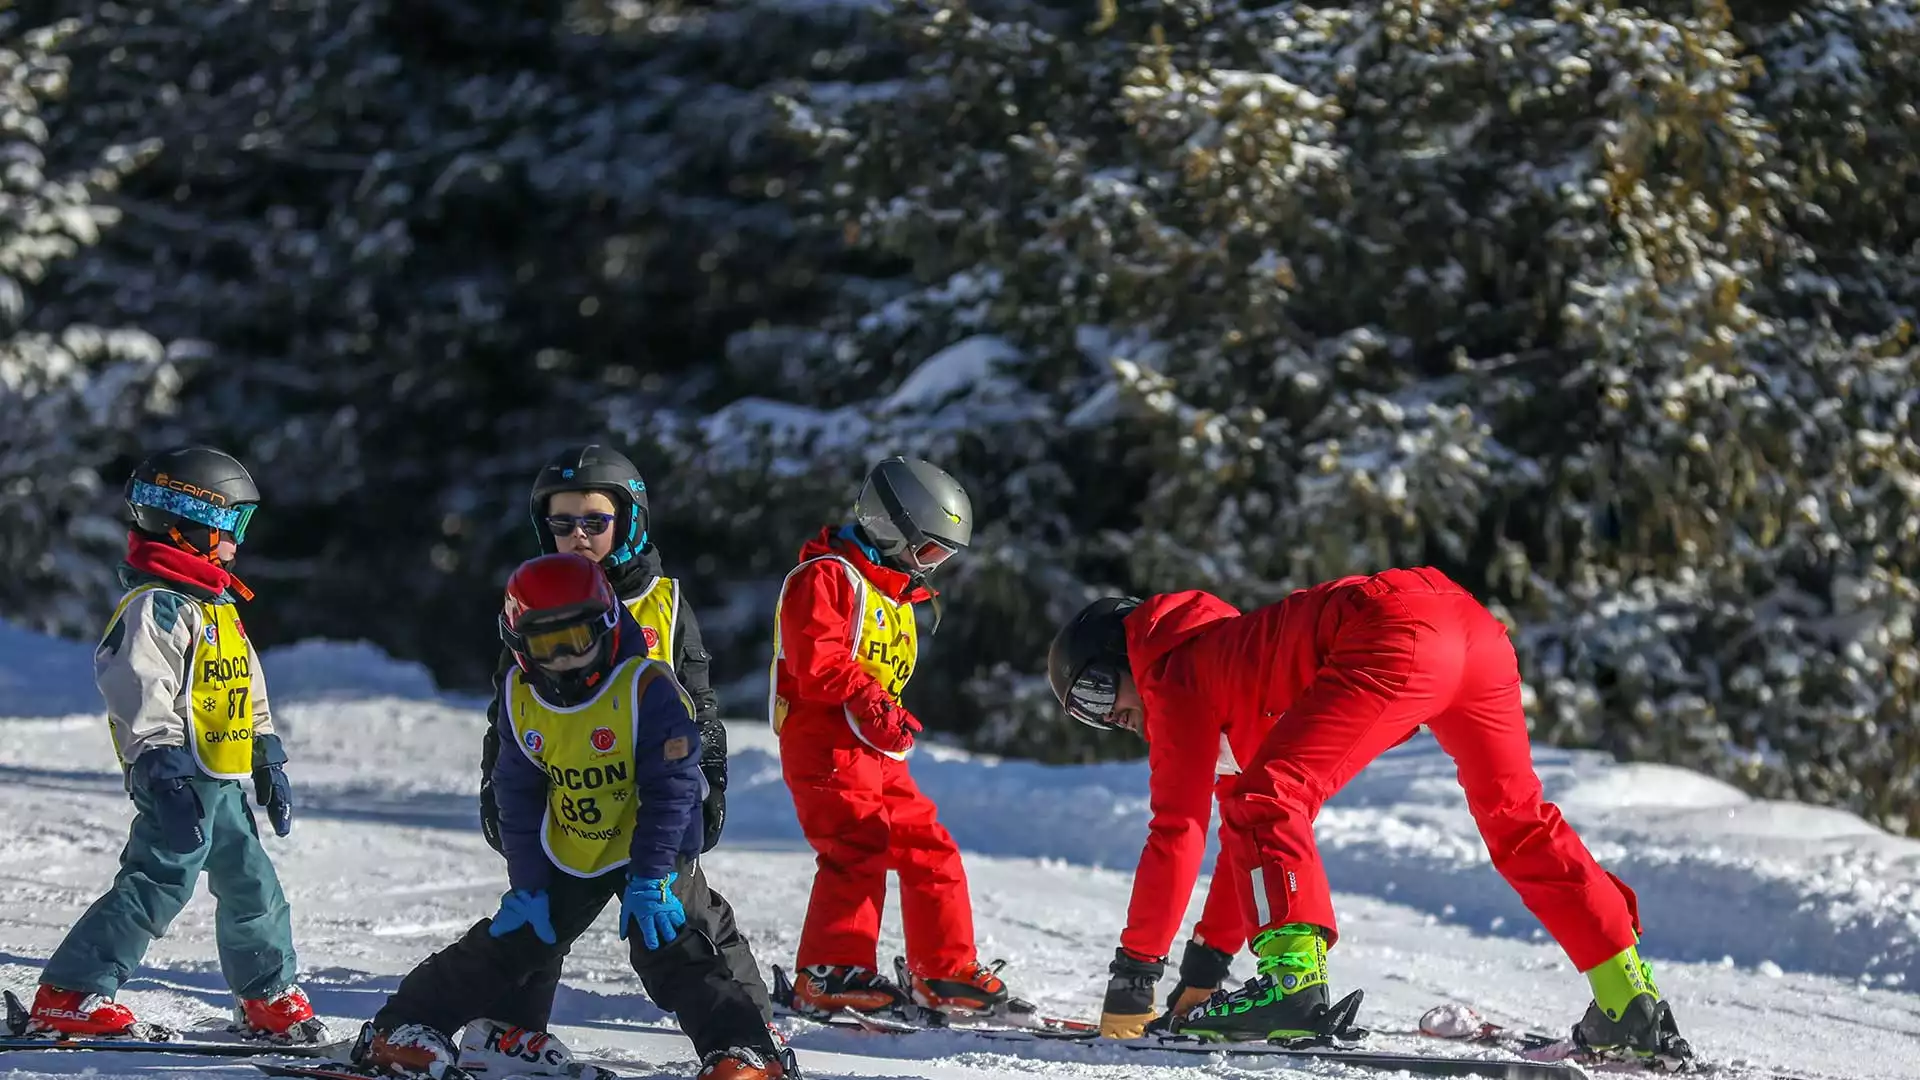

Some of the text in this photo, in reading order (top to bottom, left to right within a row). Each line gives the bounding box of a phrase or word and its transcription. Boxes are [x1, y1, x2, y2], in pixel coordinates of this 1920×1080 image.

[228, 686, 248, 720] 87
[561, 792, 602, 824] 88
[37, 1007, 90, 1021] HEAD
